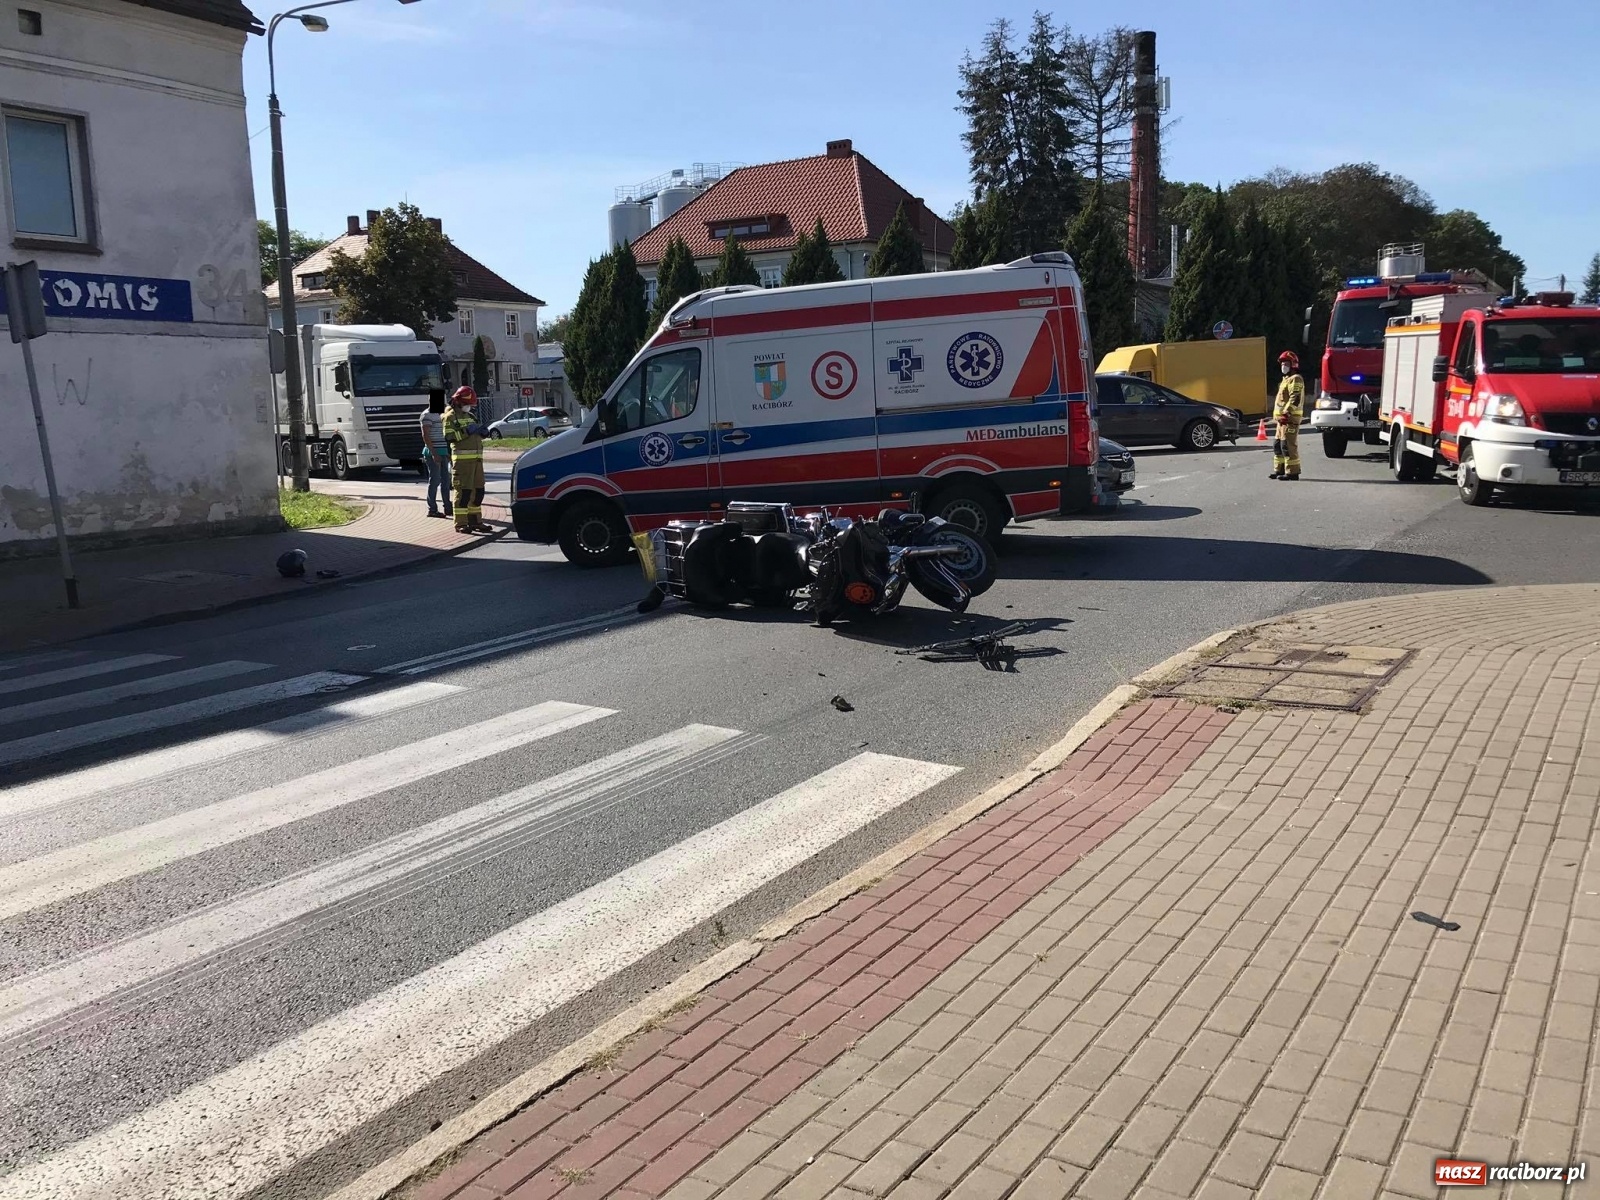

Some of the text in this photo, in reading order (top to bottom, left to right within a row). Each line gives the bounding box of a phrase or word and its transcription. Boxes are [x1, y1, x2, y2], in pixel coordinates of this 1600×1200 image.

[754, 353, 785, 361] POWIAT
[825, 362, 843, 389] S
[752, 401, 793, 410] RACIBÓRZ
[966, 424, 1066, 441] MEDambulans
[1567, 472, 1589, 482] SRC
